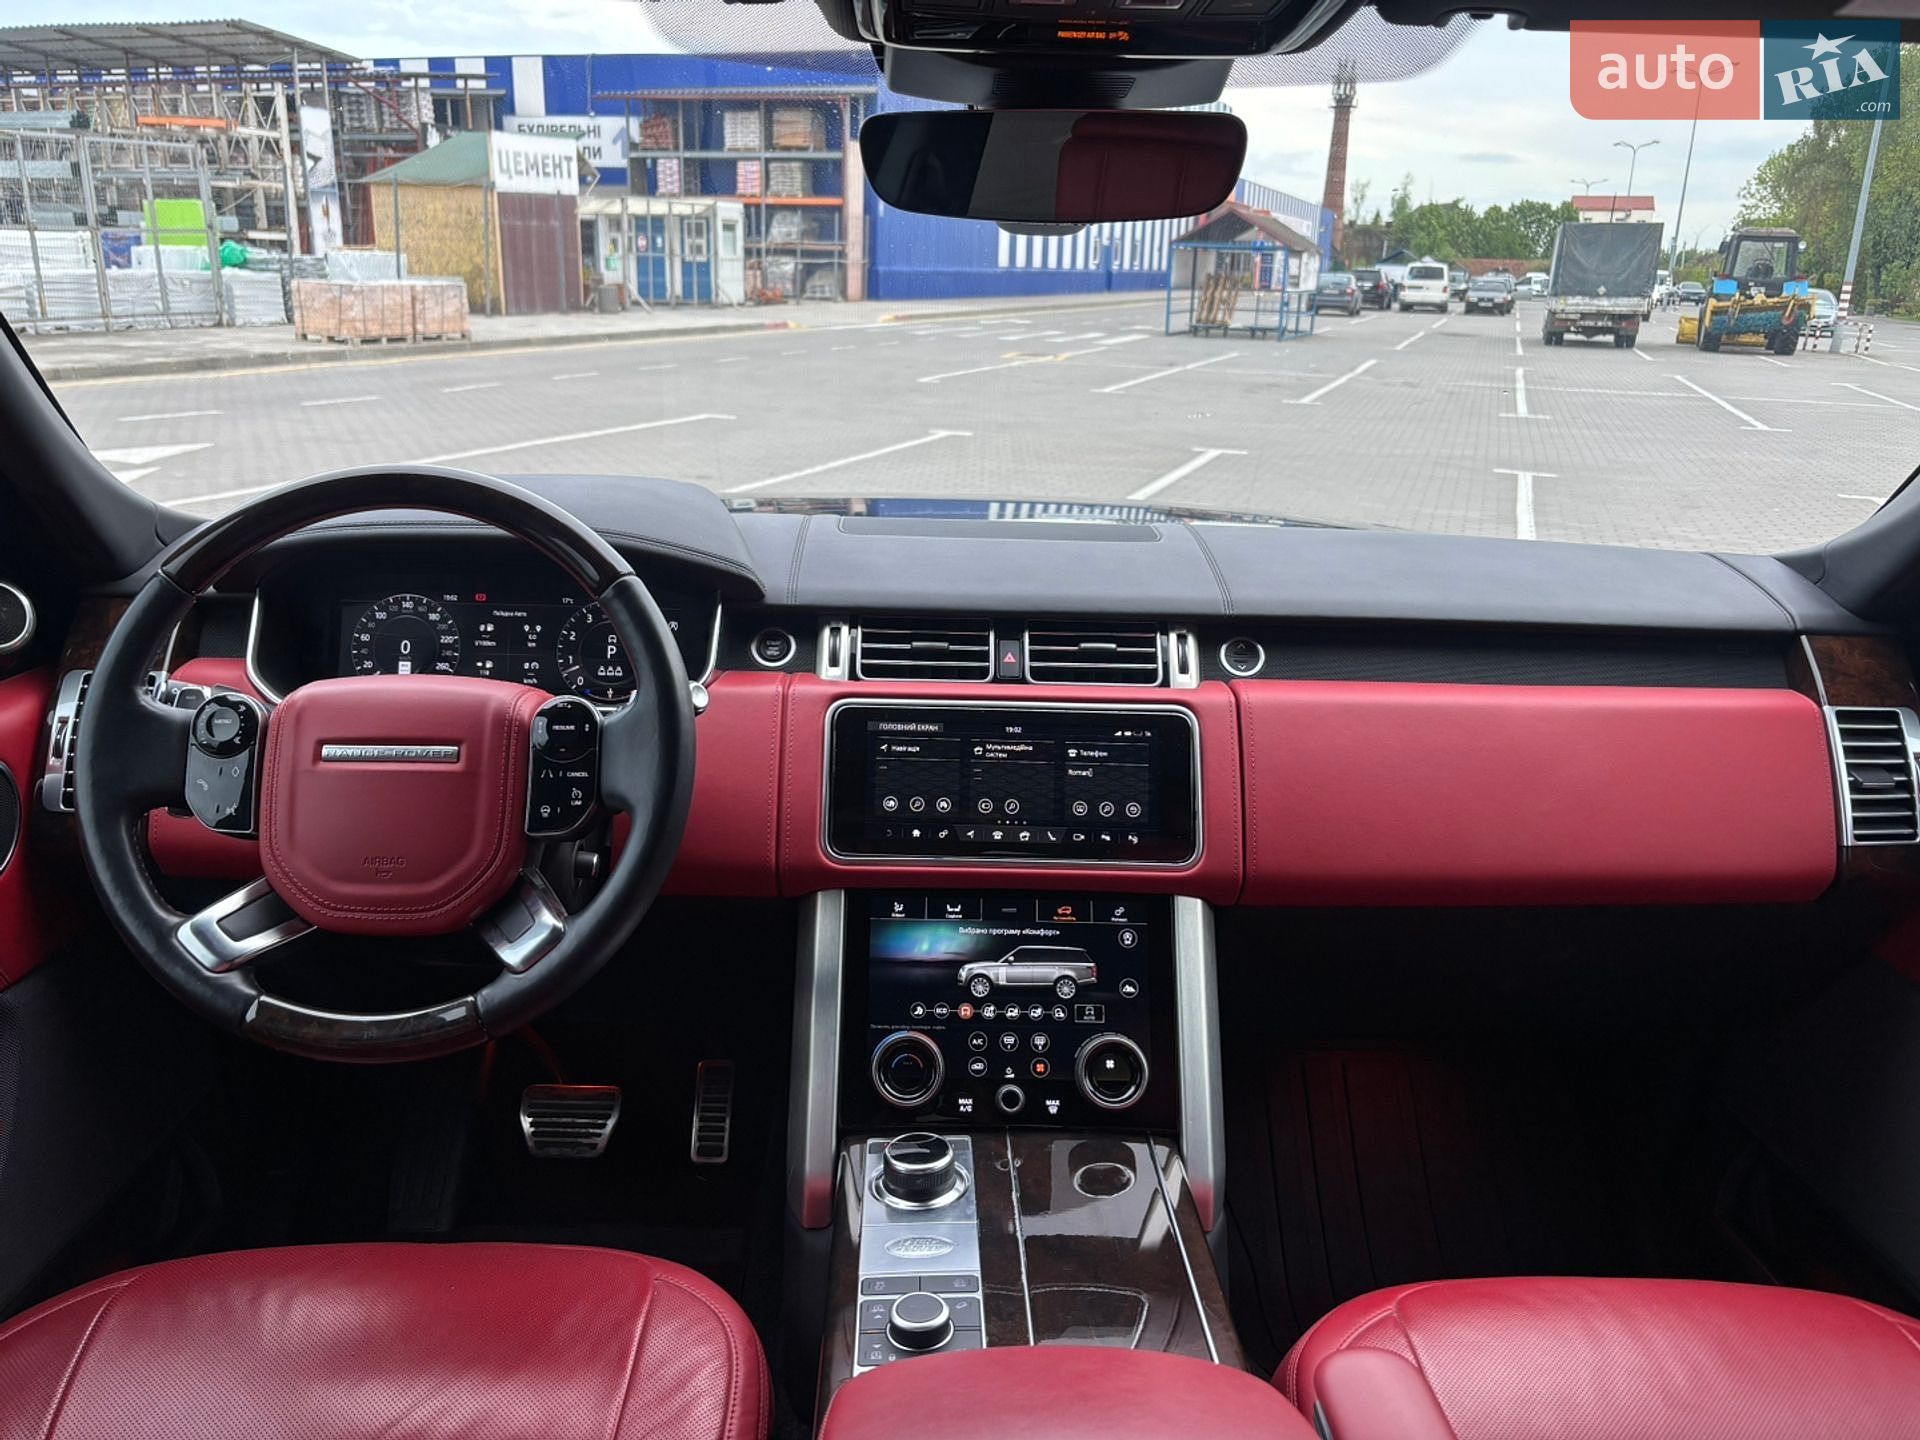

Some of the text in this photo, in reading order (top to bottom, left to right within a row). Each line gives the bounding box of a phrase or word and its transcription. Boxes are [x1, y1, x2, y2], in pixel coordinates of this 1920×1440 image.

[497, 149, 573, 180] ЦЕМЕНТ
[401, 602, 414, 610] 140
[375, 611, 388, 621] 100
[428, 612, 441, 622] 180
[586, 613, 593, 623] 3
[360, 632, 371, 642] 60
[440, 634, 455, 644] 220
[569, 631, 576, 641] 2
[401, 639, 411, 655] 0
[607, 645, 617, 659] P
[362, 660, 374, 669] 20
[568, 656, 573, 664] 1
[436, 662, 451, 671] 260
[577, 676, 584, 686] 0
[878, 722, 939, 732] ГОЛОВНИЙ ЕКРАН
[1005, 726, 1022, 734] 19:02
[566, 770, 589, 778] CANCEL
[363, 855, 406, 867] AIRBAG
[958, 926, 988, 935] Вибрано
[988, 928, 1021, 937] програму
[971, 1038, 984, 1046] A/C
